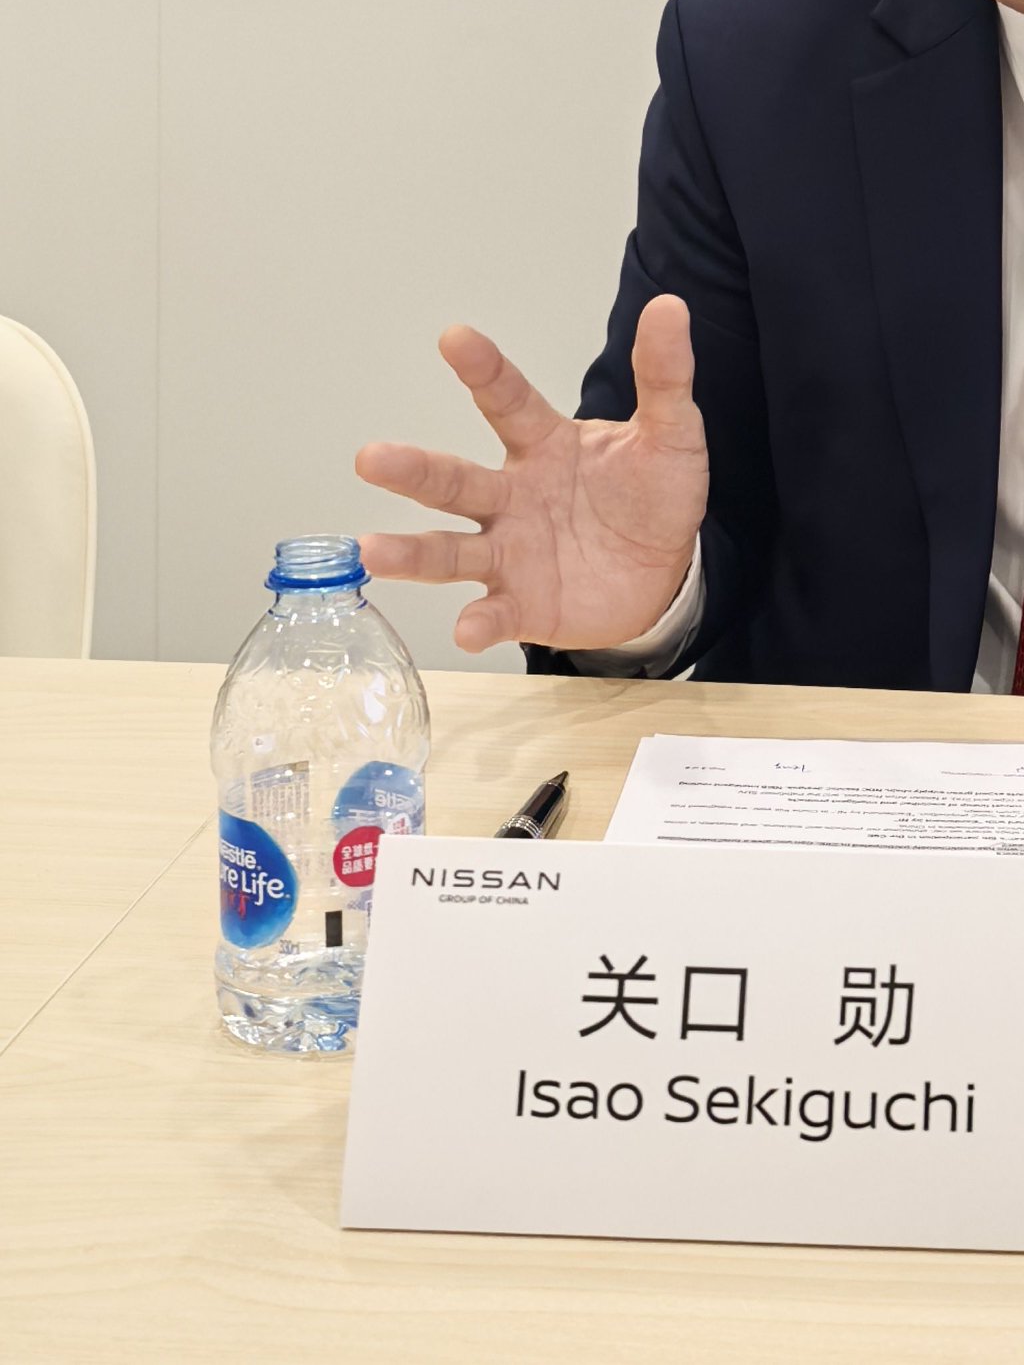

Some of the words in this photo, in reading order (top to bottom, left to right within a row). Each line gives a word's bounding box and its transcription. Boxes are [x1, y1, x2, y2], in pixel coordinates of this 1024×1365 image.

[221, 840, 257, 868] estlé
[241, 869, 285, 906] Life
[411, 867, 561, 891] NISSAN
[438, 893, 477, 905] GROUP
[478, 895, 493, 905] OF
[495, 895, 529, 906] CHINA
[578, 954, 749, 1042] 关口
[833, 963, 915, 1048] 勋
[516, 1069, 644, 1122] Isao
[664, 1074, 976, 1143] Sekiguchi
